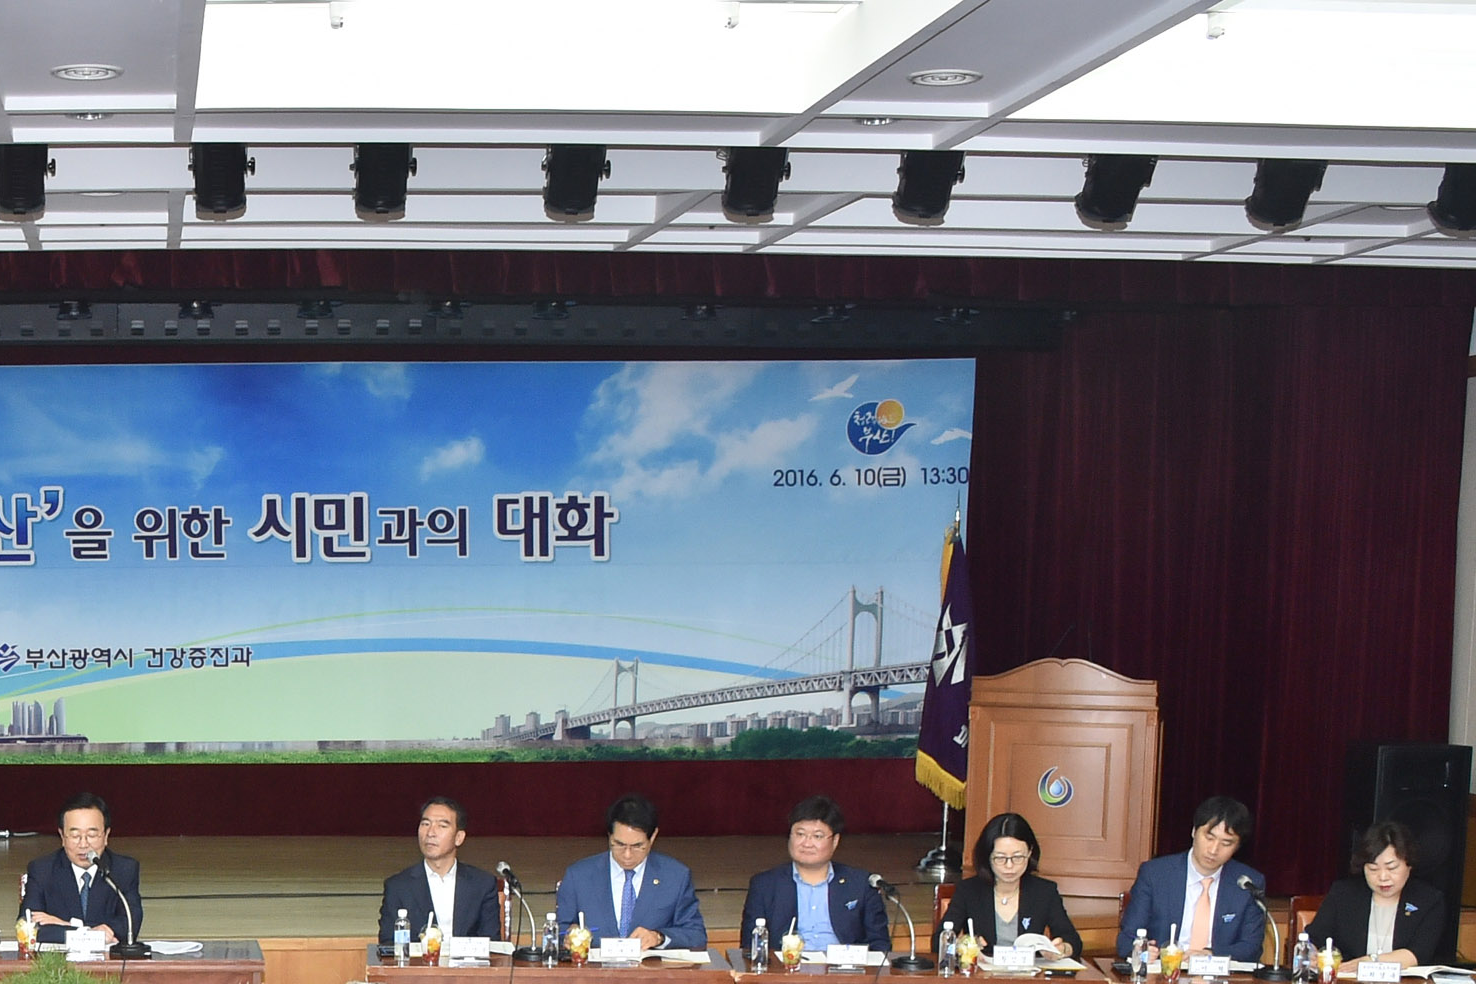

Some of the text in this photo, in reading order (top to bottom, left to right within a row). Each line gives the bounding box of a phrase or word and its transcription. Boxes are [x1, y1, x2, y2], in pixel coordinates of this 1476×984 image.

[773, 466, 969, 488] 2016. 6. 10(금) 13:30
[133, 506, 231, 560] 위한
[250, 492, 469, 563] 시민과의
[494, 490, 619, 563] 대화
[25, 646, 253, 670] 부산광역시 건강증진과
